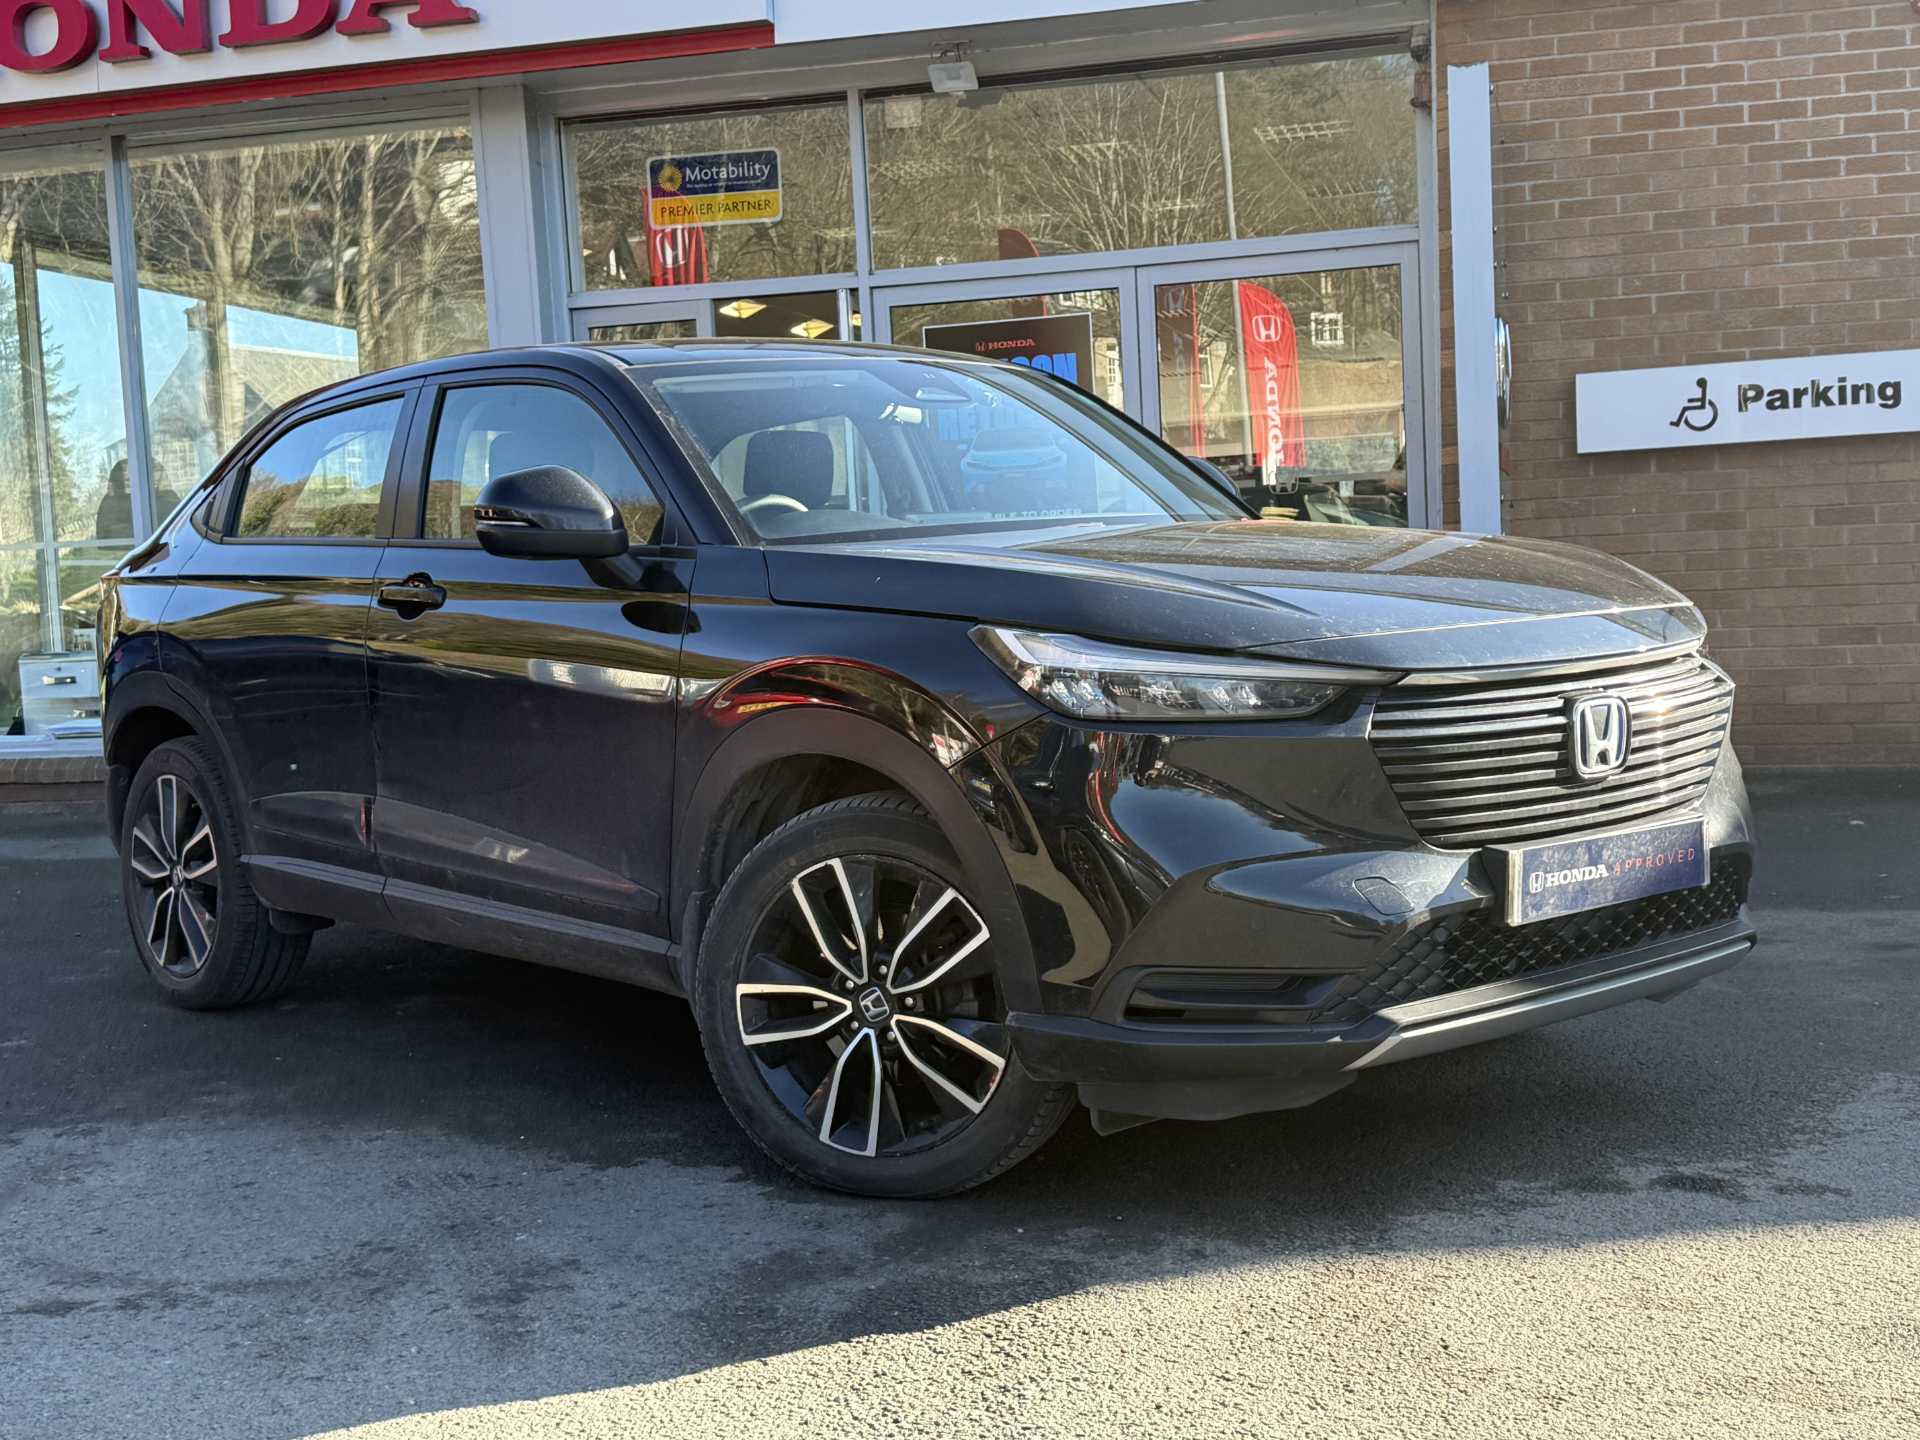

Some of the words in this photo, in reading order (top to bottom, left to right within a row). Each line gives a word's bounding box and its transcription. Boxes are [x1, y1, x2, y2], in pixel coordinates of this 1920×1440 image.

[685, 162, 771, 181] Motability
[661, 203, 713, 217] PREMIER
[718, 200, 771, 213] PARTNER
[989, 339, 1036, 349] HONDA
[1738, 376, 1902, 412] Parking
[1545, 864, 1609, 887] HONDA
[1615, 848, 1696, 876] APPROVED
